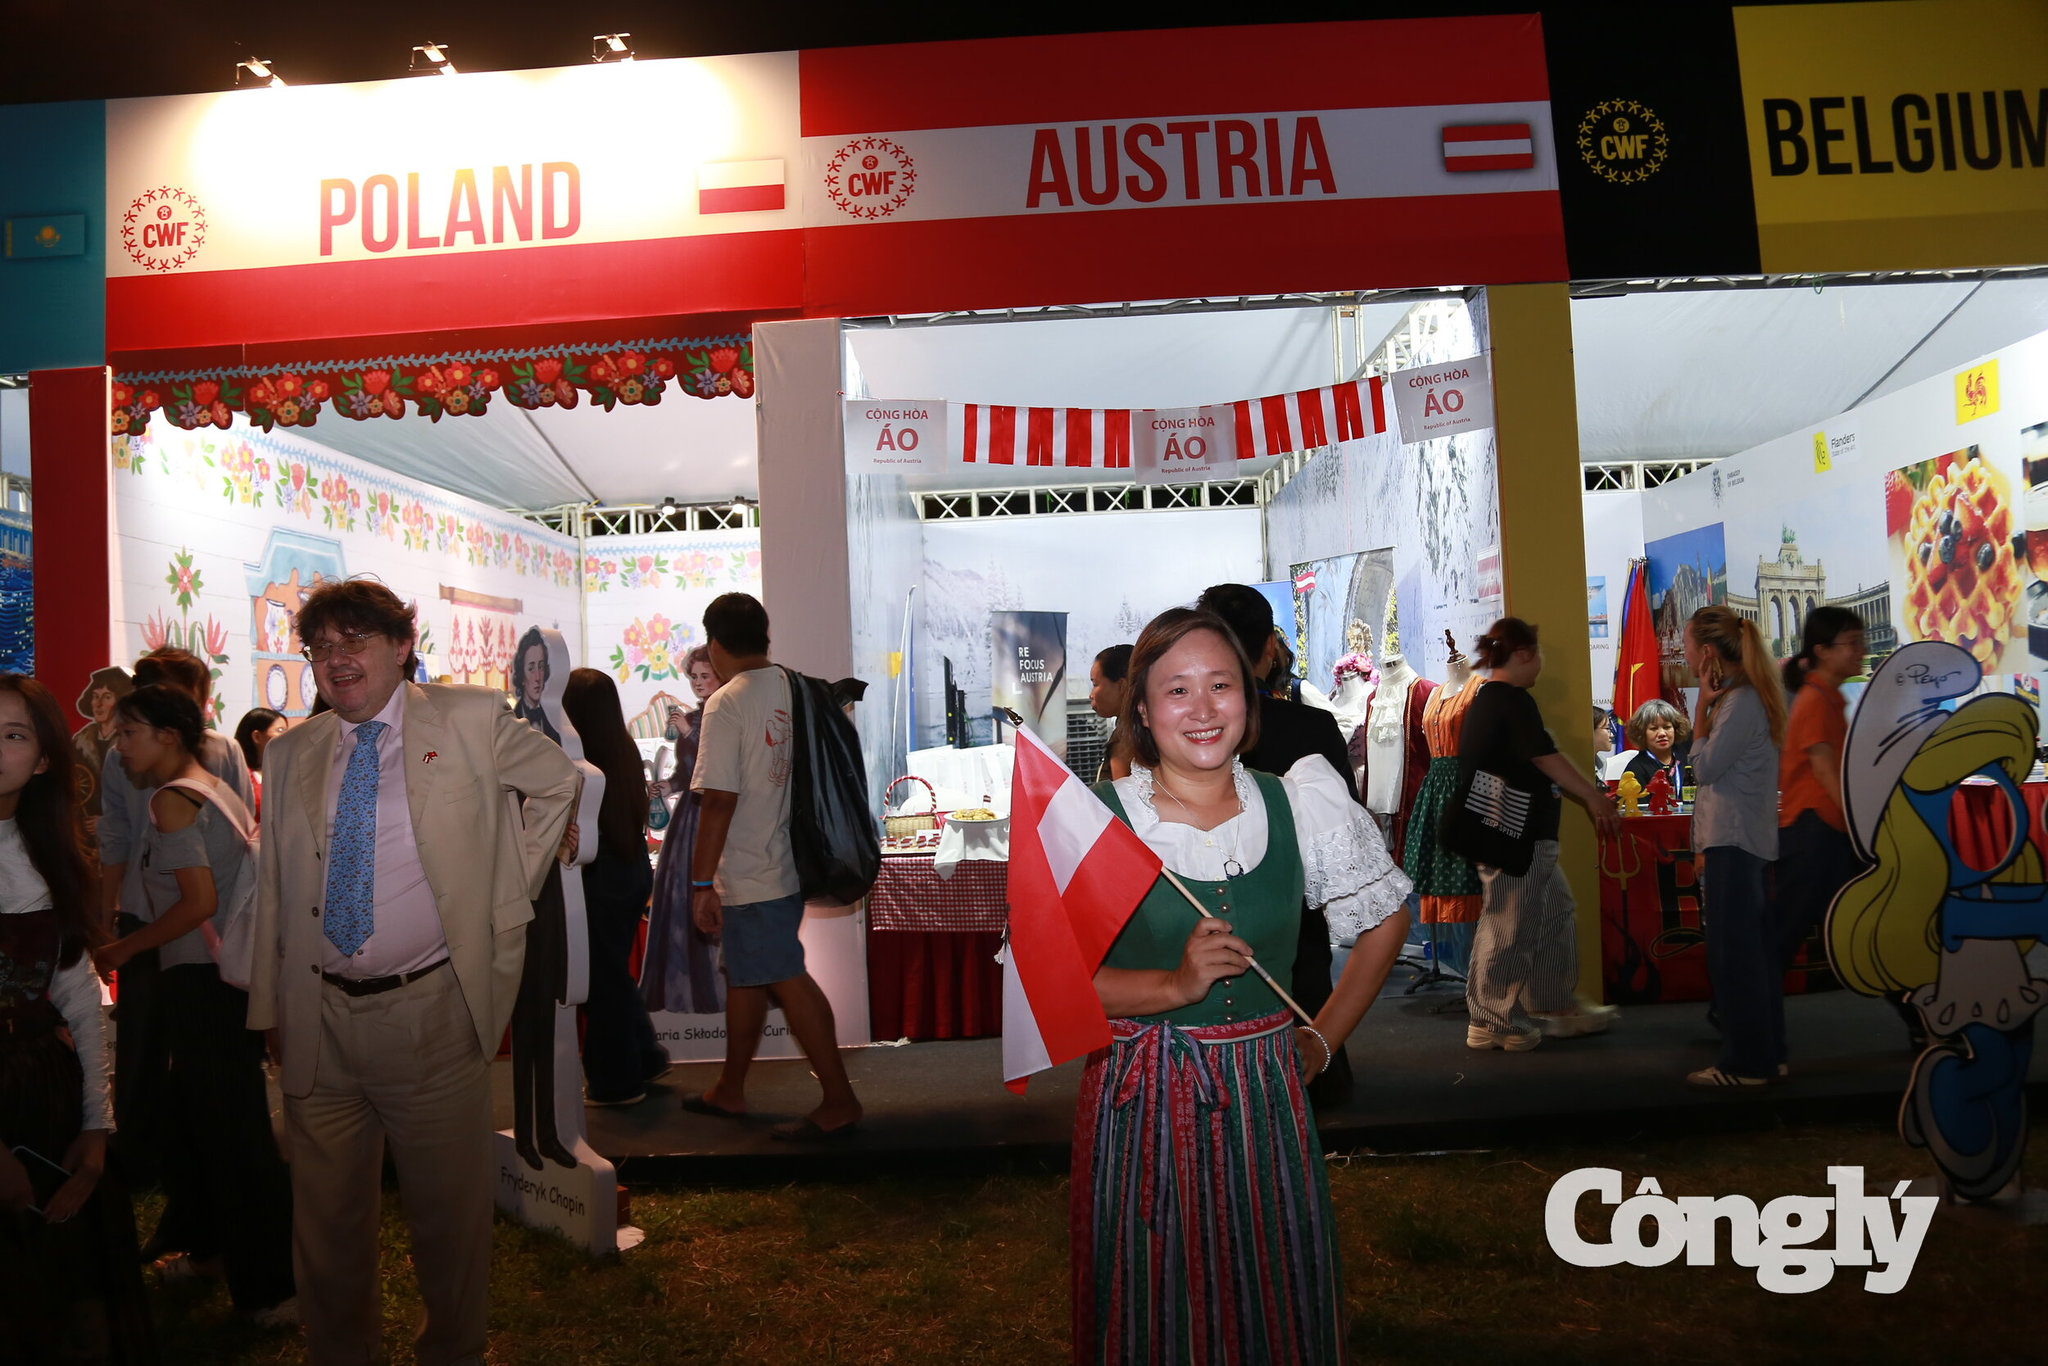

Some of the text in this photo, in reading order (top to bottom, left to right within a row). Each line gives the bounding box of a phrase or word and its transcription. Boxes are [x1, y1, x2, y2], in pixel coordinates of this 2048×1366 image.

[1762, 87, 2048, 177] BELGIUM
[1601, 134, 1649, 160] CWF
[1026, 116, 1337, 208] AUSTRIA
[848, 171, 897, 197] CWF
[320, 161, 581, 256] POLAND
[143, 221, 189, 248] CWF
[1409, 368, 1470, 389] CỘNG HÒA
[865, 407, 929, 422] CỘNG HÒA
[1424, 388, 1464, 417] ÁO
[1151, 416, 1215, 432] CỘNG HÒA
[1423, 421, 1446, 430] Republic
[1452, 417, 1471, 425] Austria
[876, 423, 919, 451] ÁO
[1163, 432, 1207, 461] ÁO
[1161, 466, 1184, 474] Republic
[1018, 646, 1030, 658] RE
[1019, 659, 1045, 670] FOCUS
[1020, 672, 1054, 683] AUSTRIA
[655, 1029, 680, 1041] aria
[500, 1166, 585, 1217] Fryderyk Chopin
